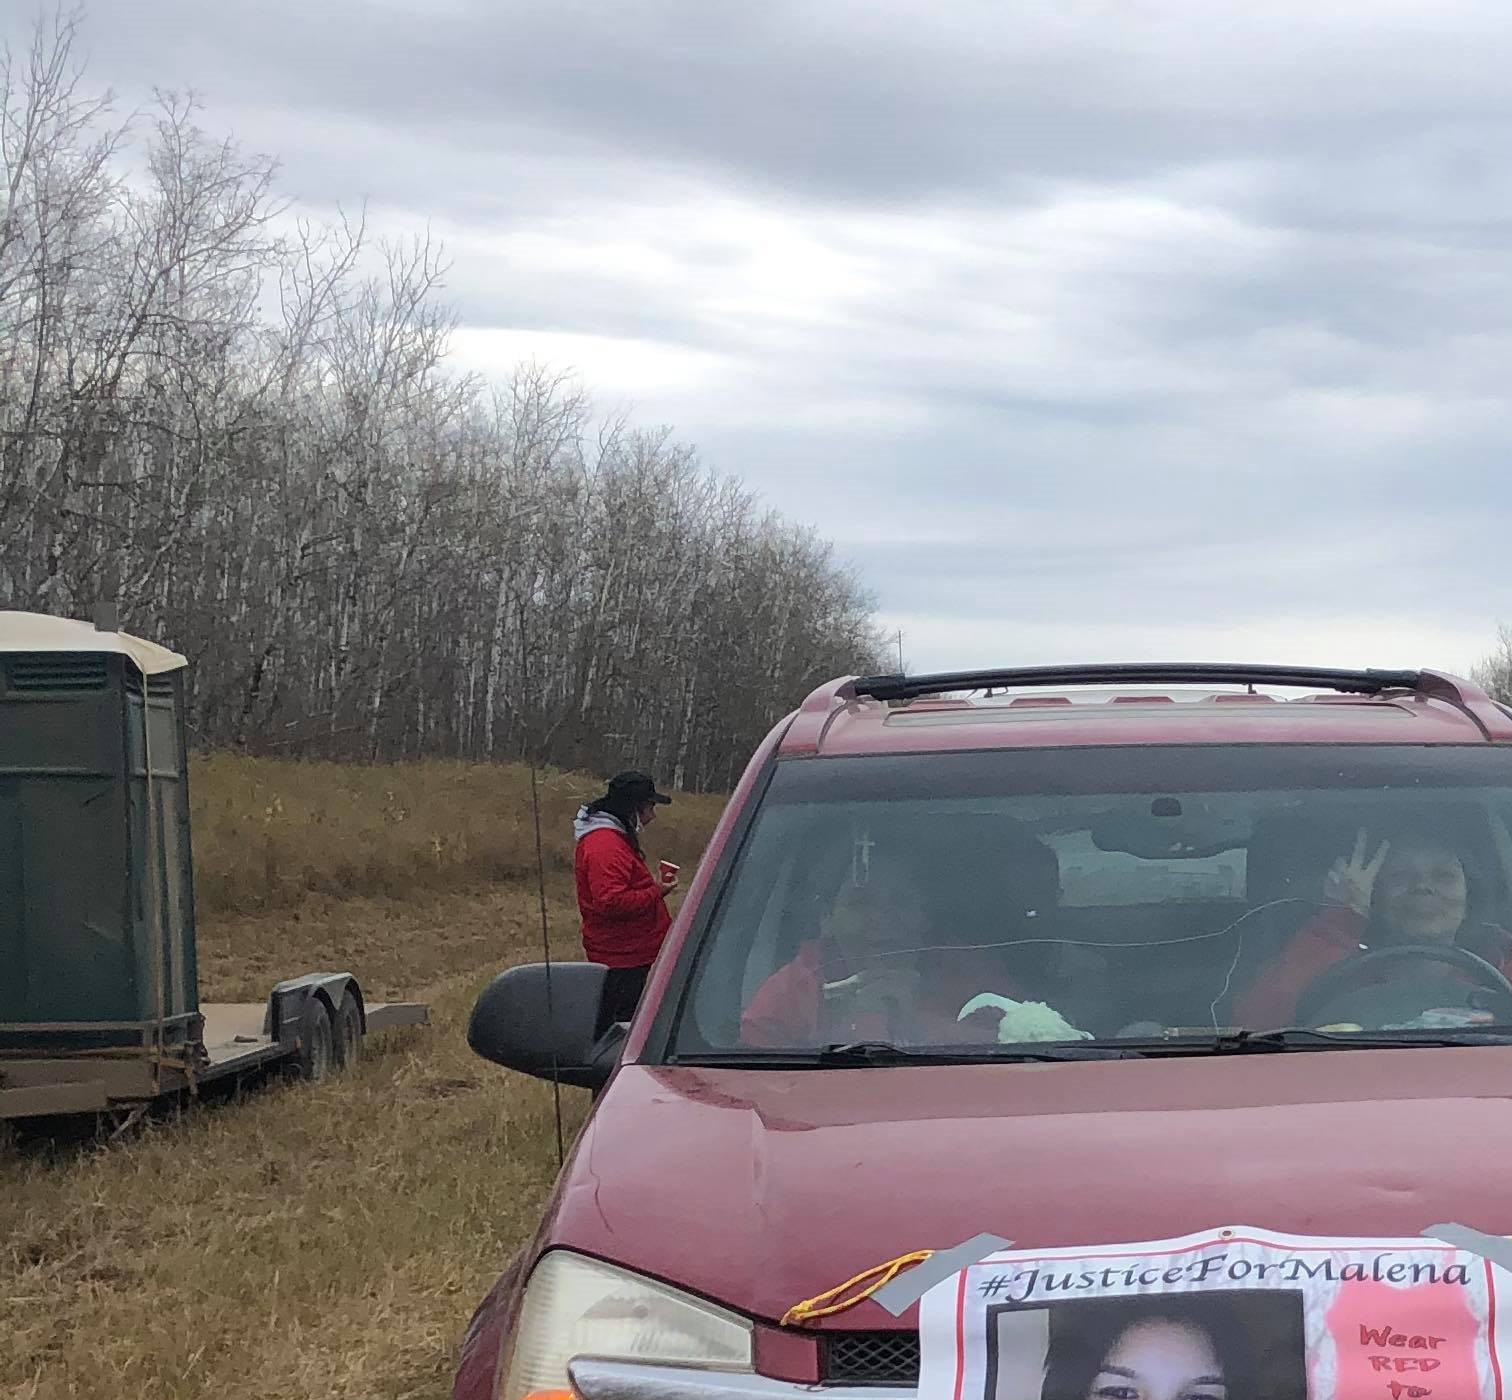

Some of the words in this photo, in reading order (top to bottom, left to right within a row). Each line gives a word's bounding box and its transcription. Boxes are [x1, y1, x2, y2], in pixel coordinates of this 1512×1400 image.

[978, 1252, 1472, 1303] #JusticeForMalena
[1359, 1323, 1447, 1350] Wear
[1368, 1355, 1441, 1373] RED
